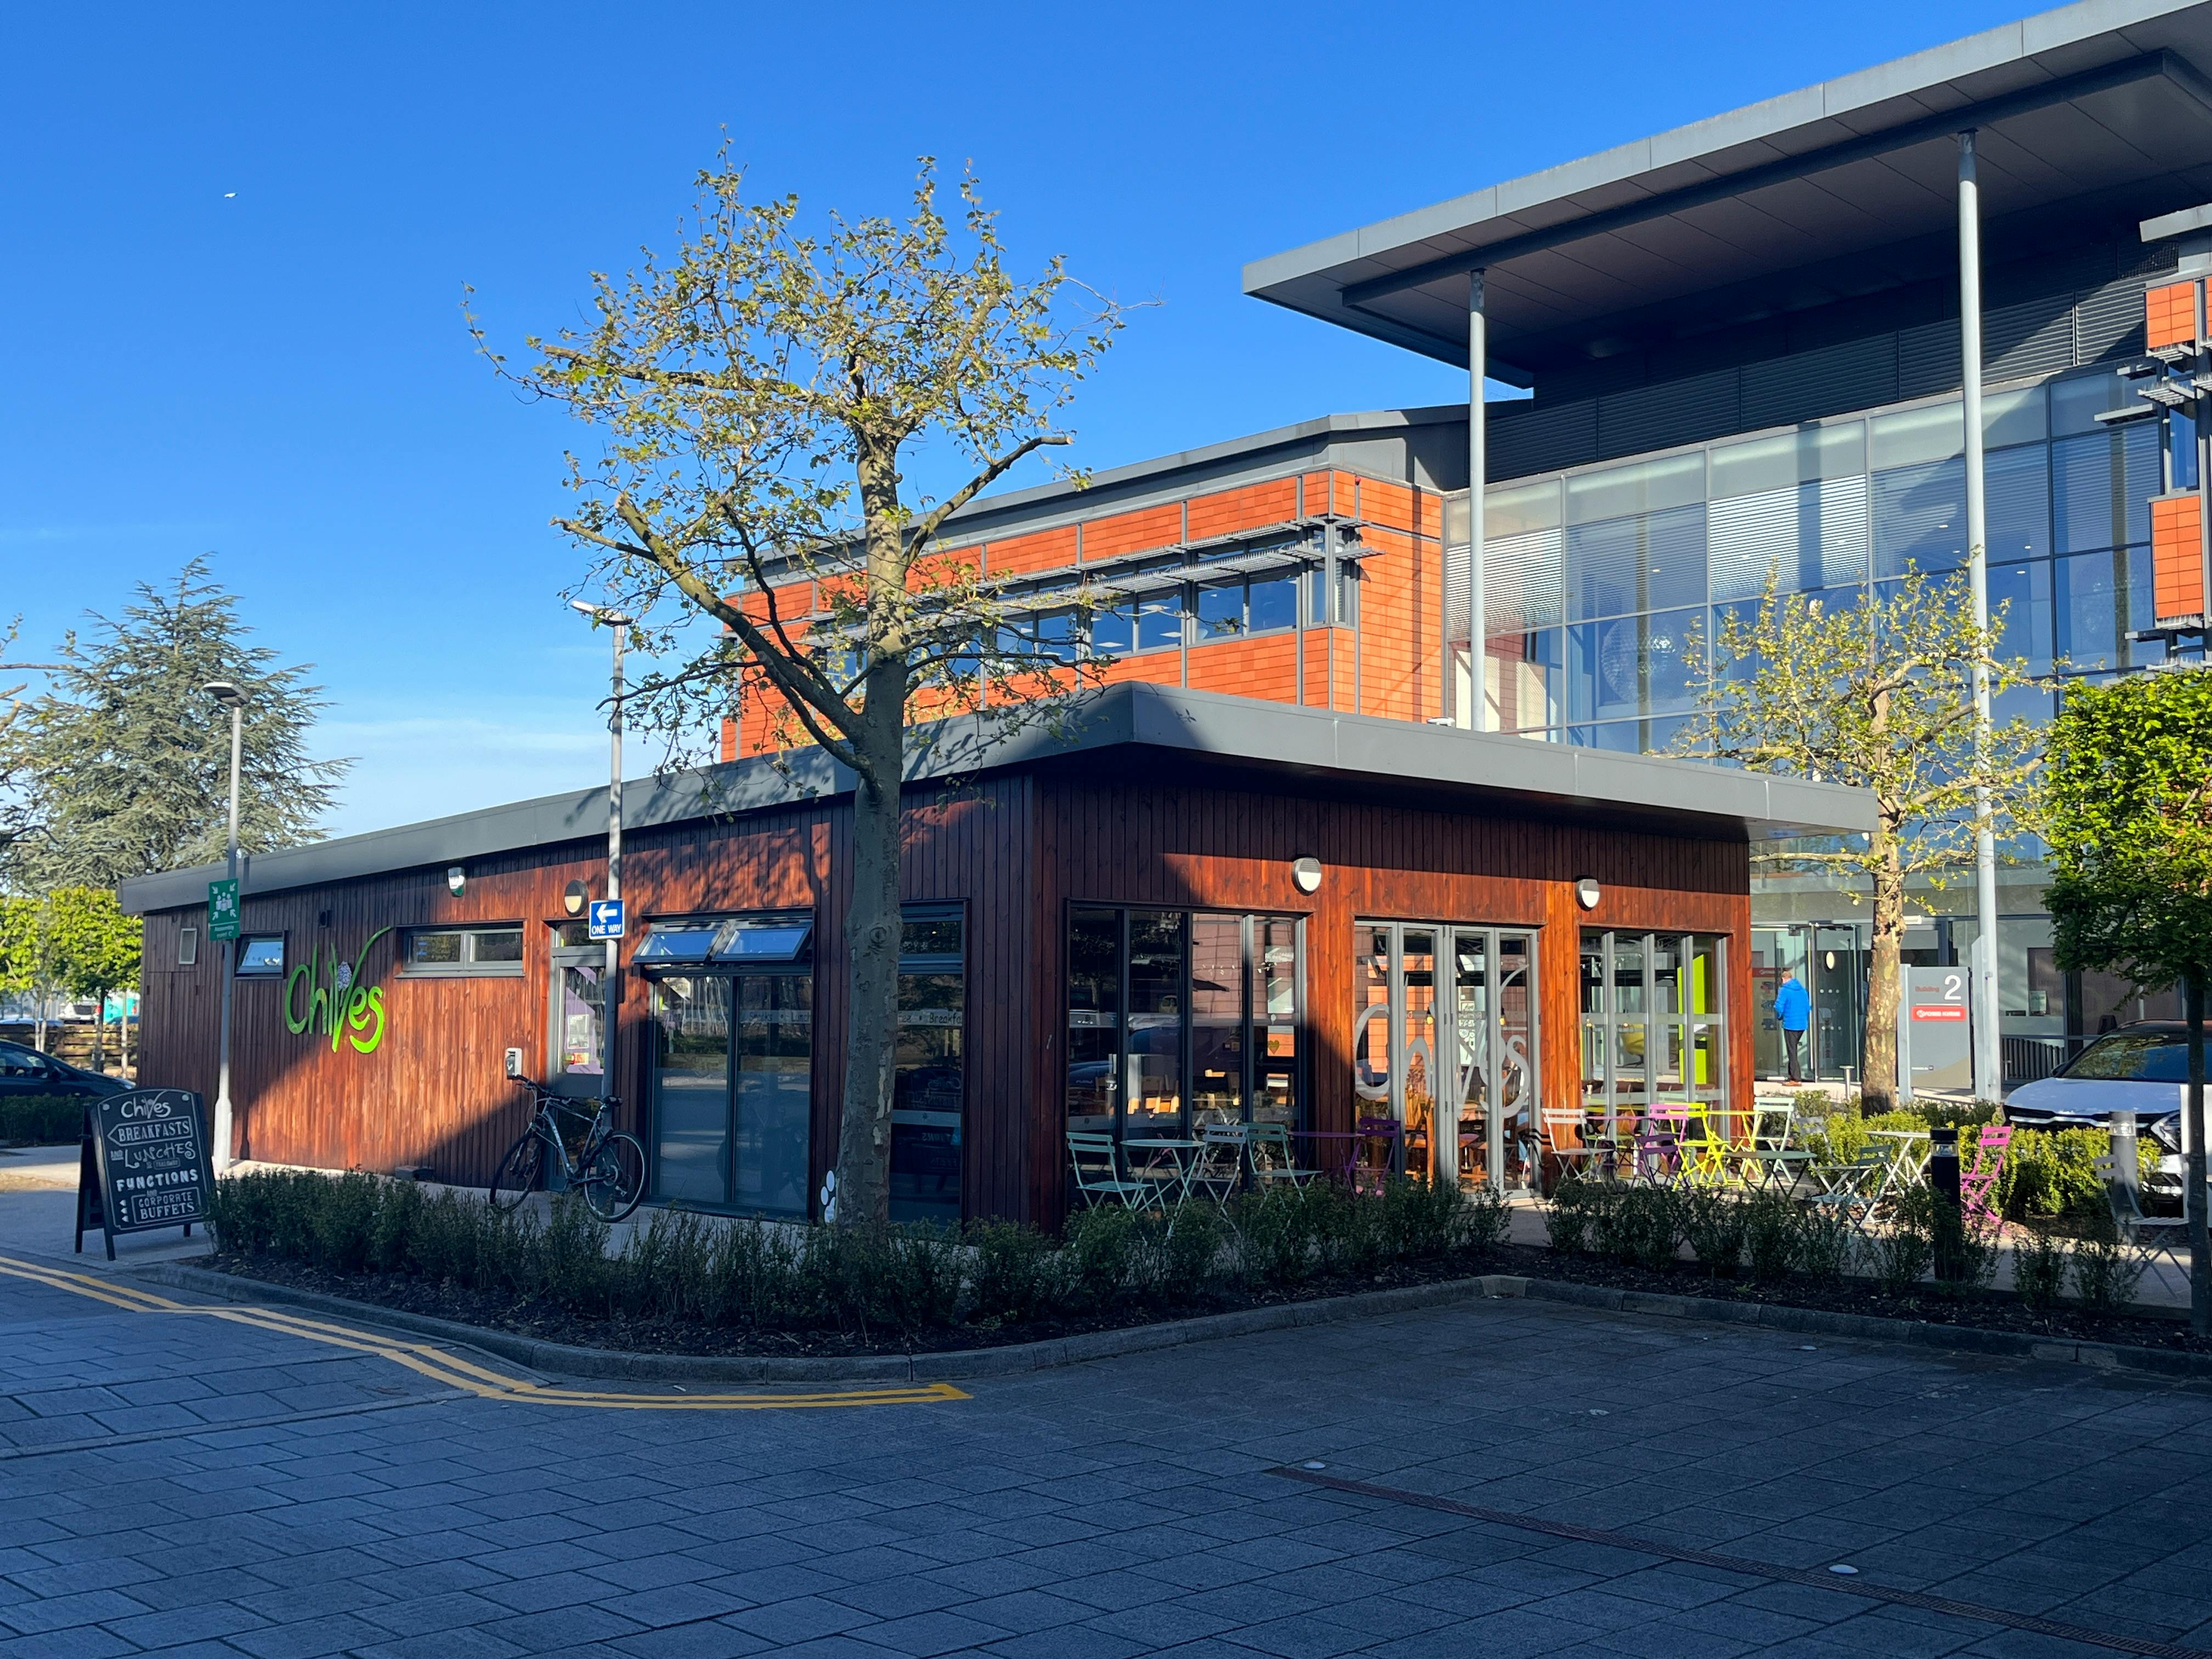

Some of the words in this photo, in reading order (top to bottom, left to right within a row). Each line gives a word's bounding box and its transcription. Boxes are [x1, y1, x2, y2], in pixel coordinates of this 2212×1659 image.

[591, 925, 606, 934] ONE
[607, 924, 622, 933] WAY
[285, 926, 391, 1053] Chives
[1944, 974, 1962, 1000] 2
[121, 1093, 171, 1119] Chives
[117, 1121, 190, 1142] BREAKFASTS
[125, 1141, 196, 1169] LUNCHES
[116, 1169, 199, 1192] FUNCTIONS
[138, 1192, 194, 1207] CORPORATE
[140, 1201, 195, 1220] BUFFETS
